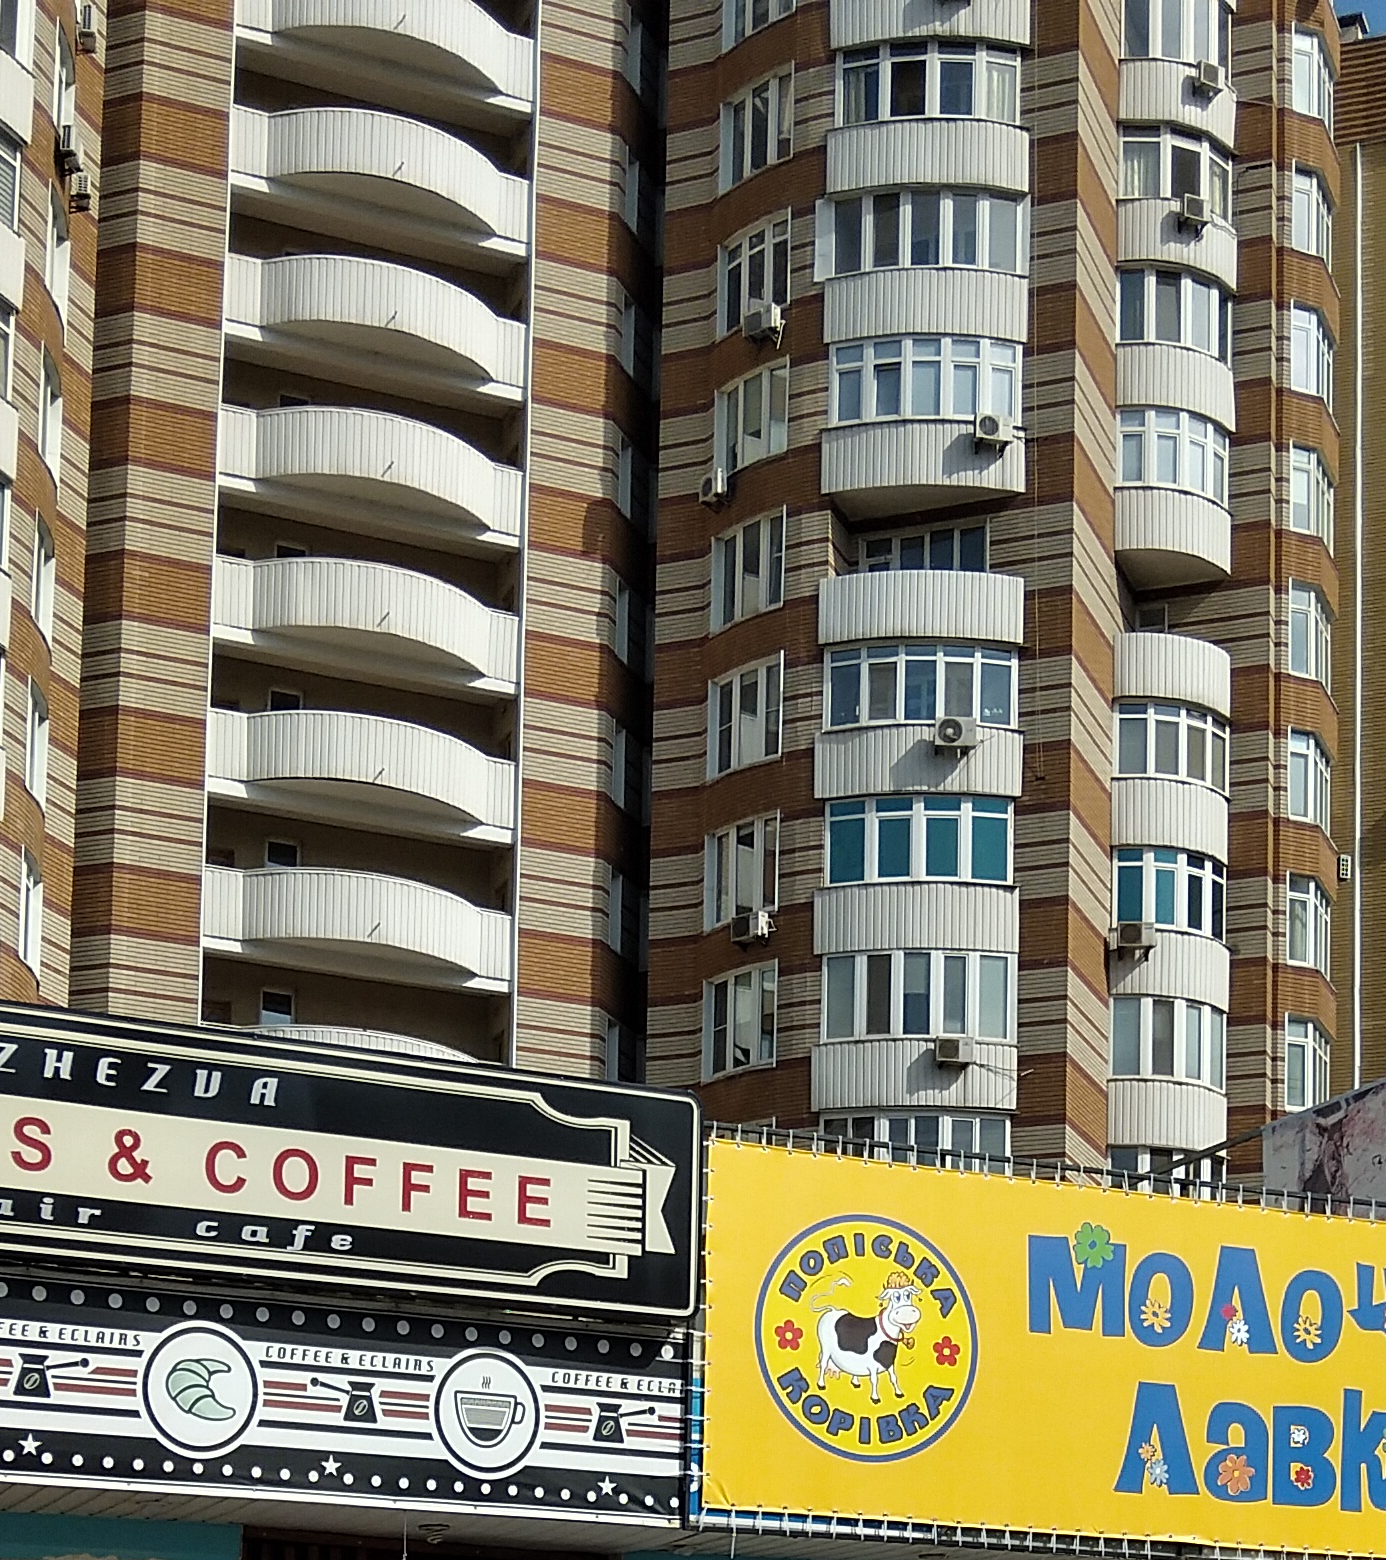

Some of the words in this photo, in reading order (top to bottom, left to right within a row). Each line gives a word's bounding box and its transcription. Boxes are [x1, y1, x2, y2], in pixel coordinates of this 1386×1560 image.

[108, 1128, 153, 1185] &
[204, 1139, 553, 1228] COFFEE
[195, 1218, 354, 1252] cafe
[57, 1327, 142, 1347] ECLAIRS
[265, 1345, 334, 1365] COFFEE
[358, 1353, 435, 1373] ECLAIRS
[551, 1371, 614, 1389] COFFEE
[776, 1366, 955, 1445] КОРІВКА
